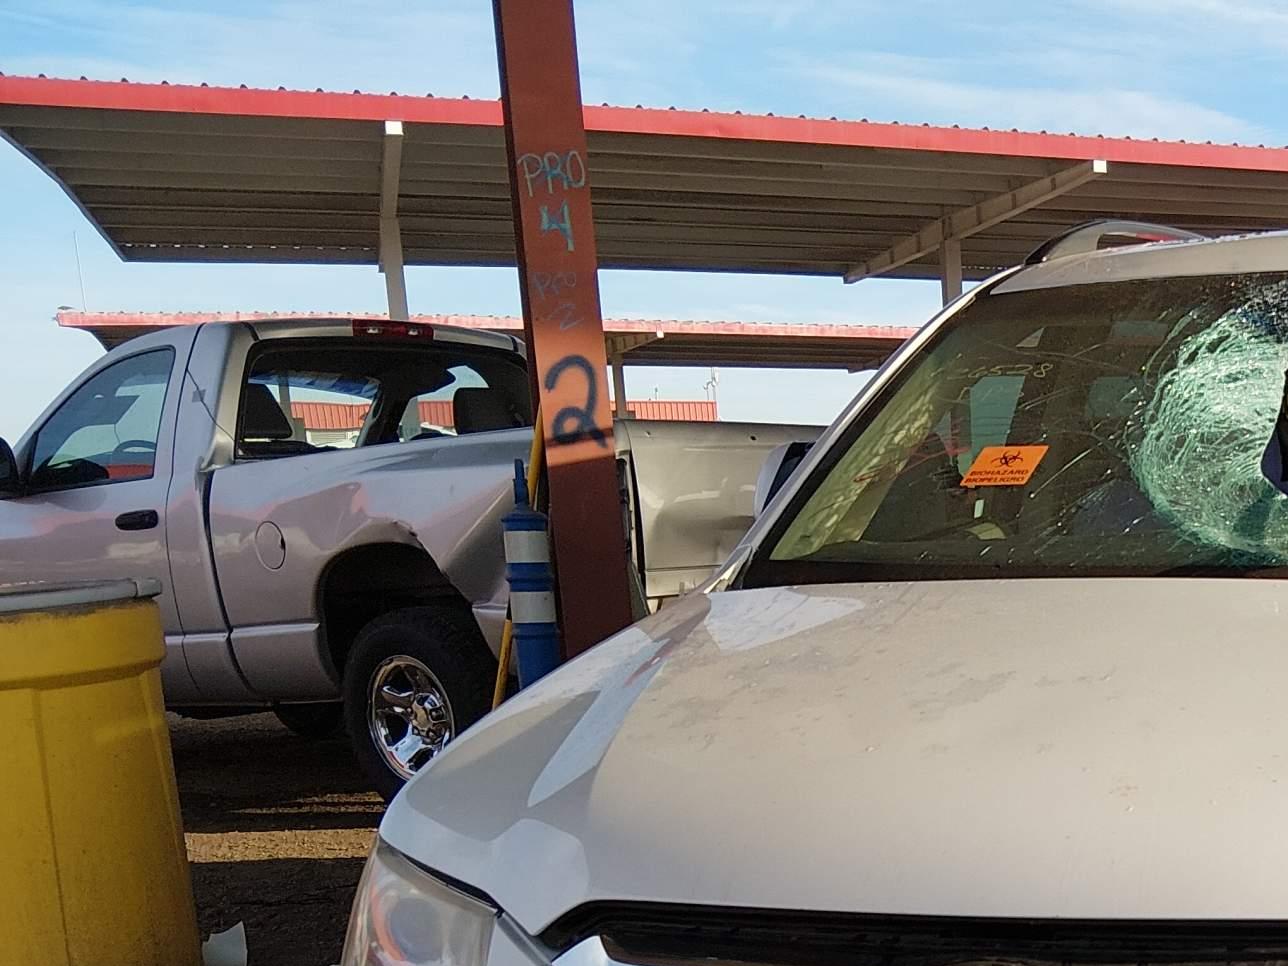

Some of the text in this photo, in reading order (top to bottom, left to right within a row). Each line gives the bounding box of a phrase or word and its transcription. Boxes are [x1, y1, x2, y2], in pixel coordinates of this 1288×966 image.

[517, 150, 585, 196] PRO
[540, 201, 574, 251] 4
[545, 355, 608, 448] 2
